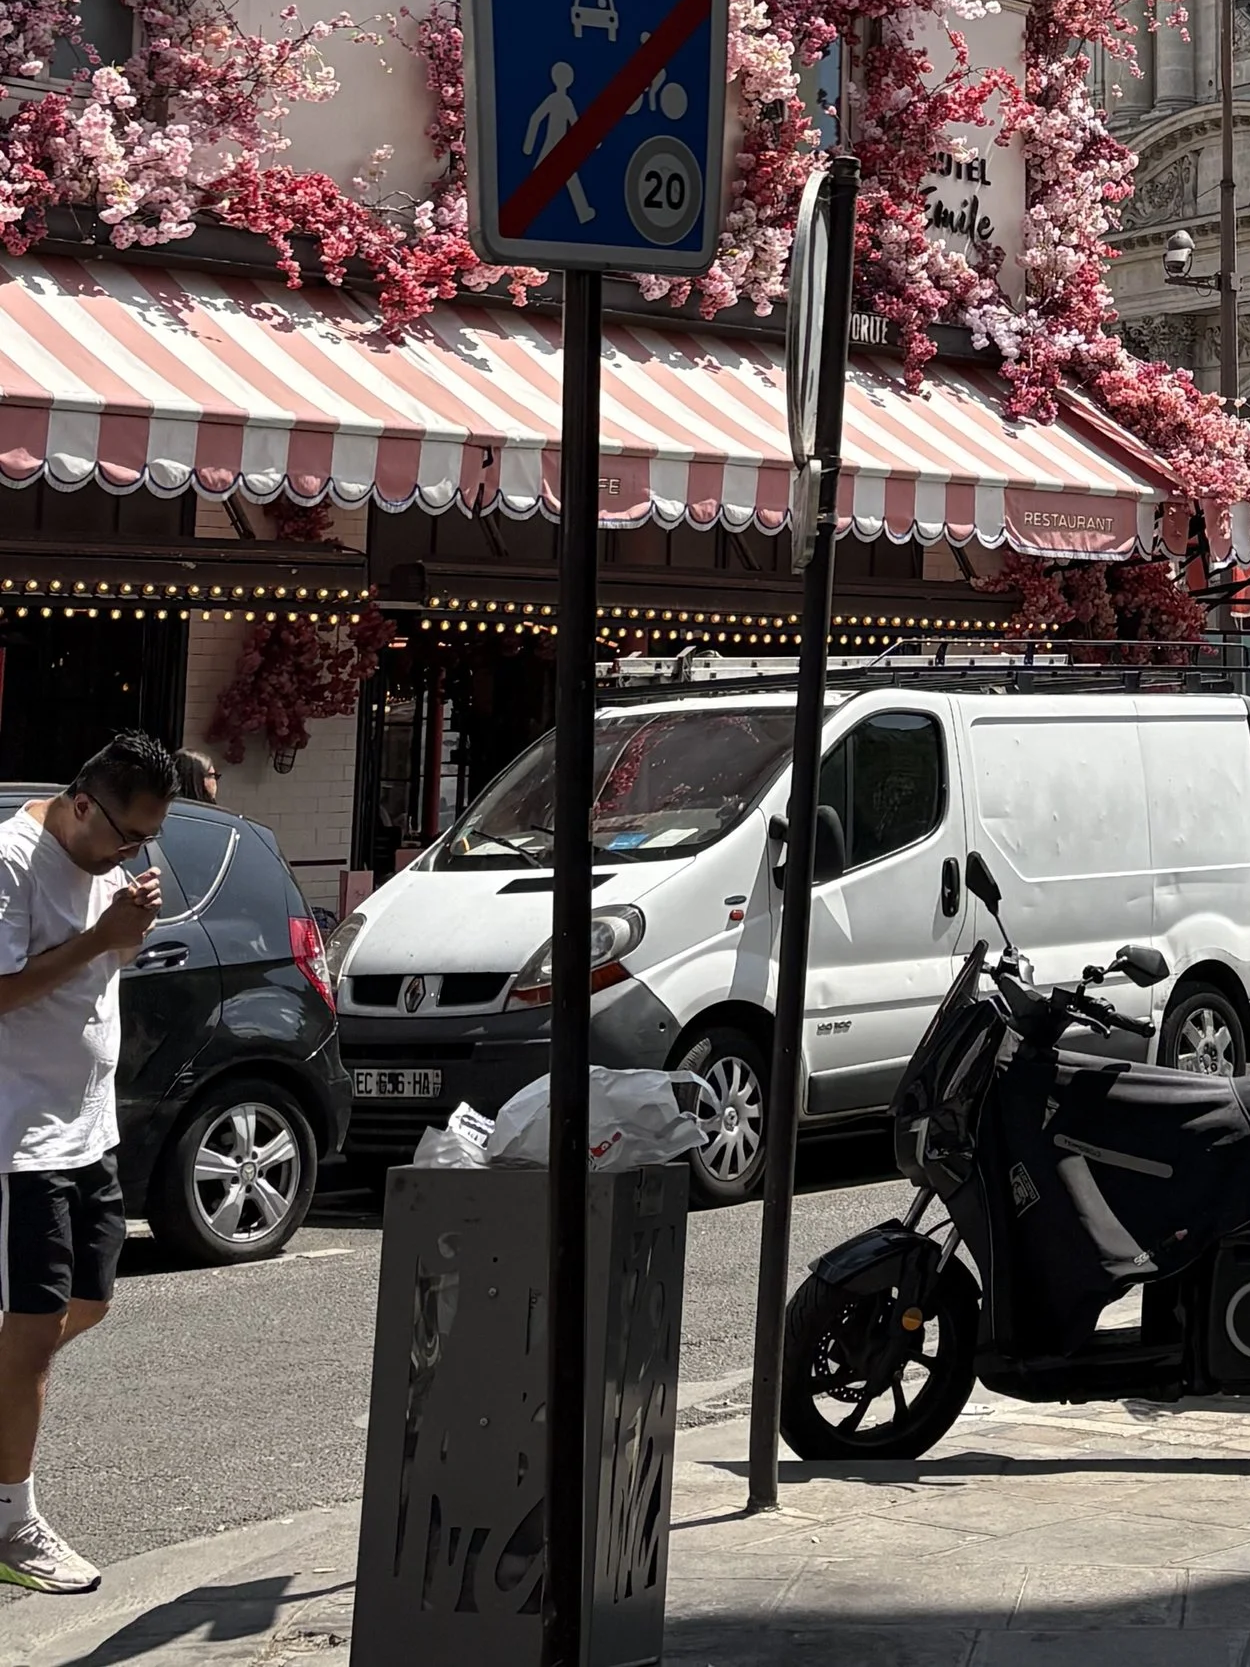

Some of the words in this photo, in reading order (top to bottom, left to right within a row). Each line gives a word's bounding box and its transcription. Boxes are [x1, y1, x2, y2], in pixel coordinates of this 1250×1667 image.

[643, 170, 686, 211] 20
[598, 478, 621, 496] FE
[1023, 511, 1115, 533] RESTAURANT
